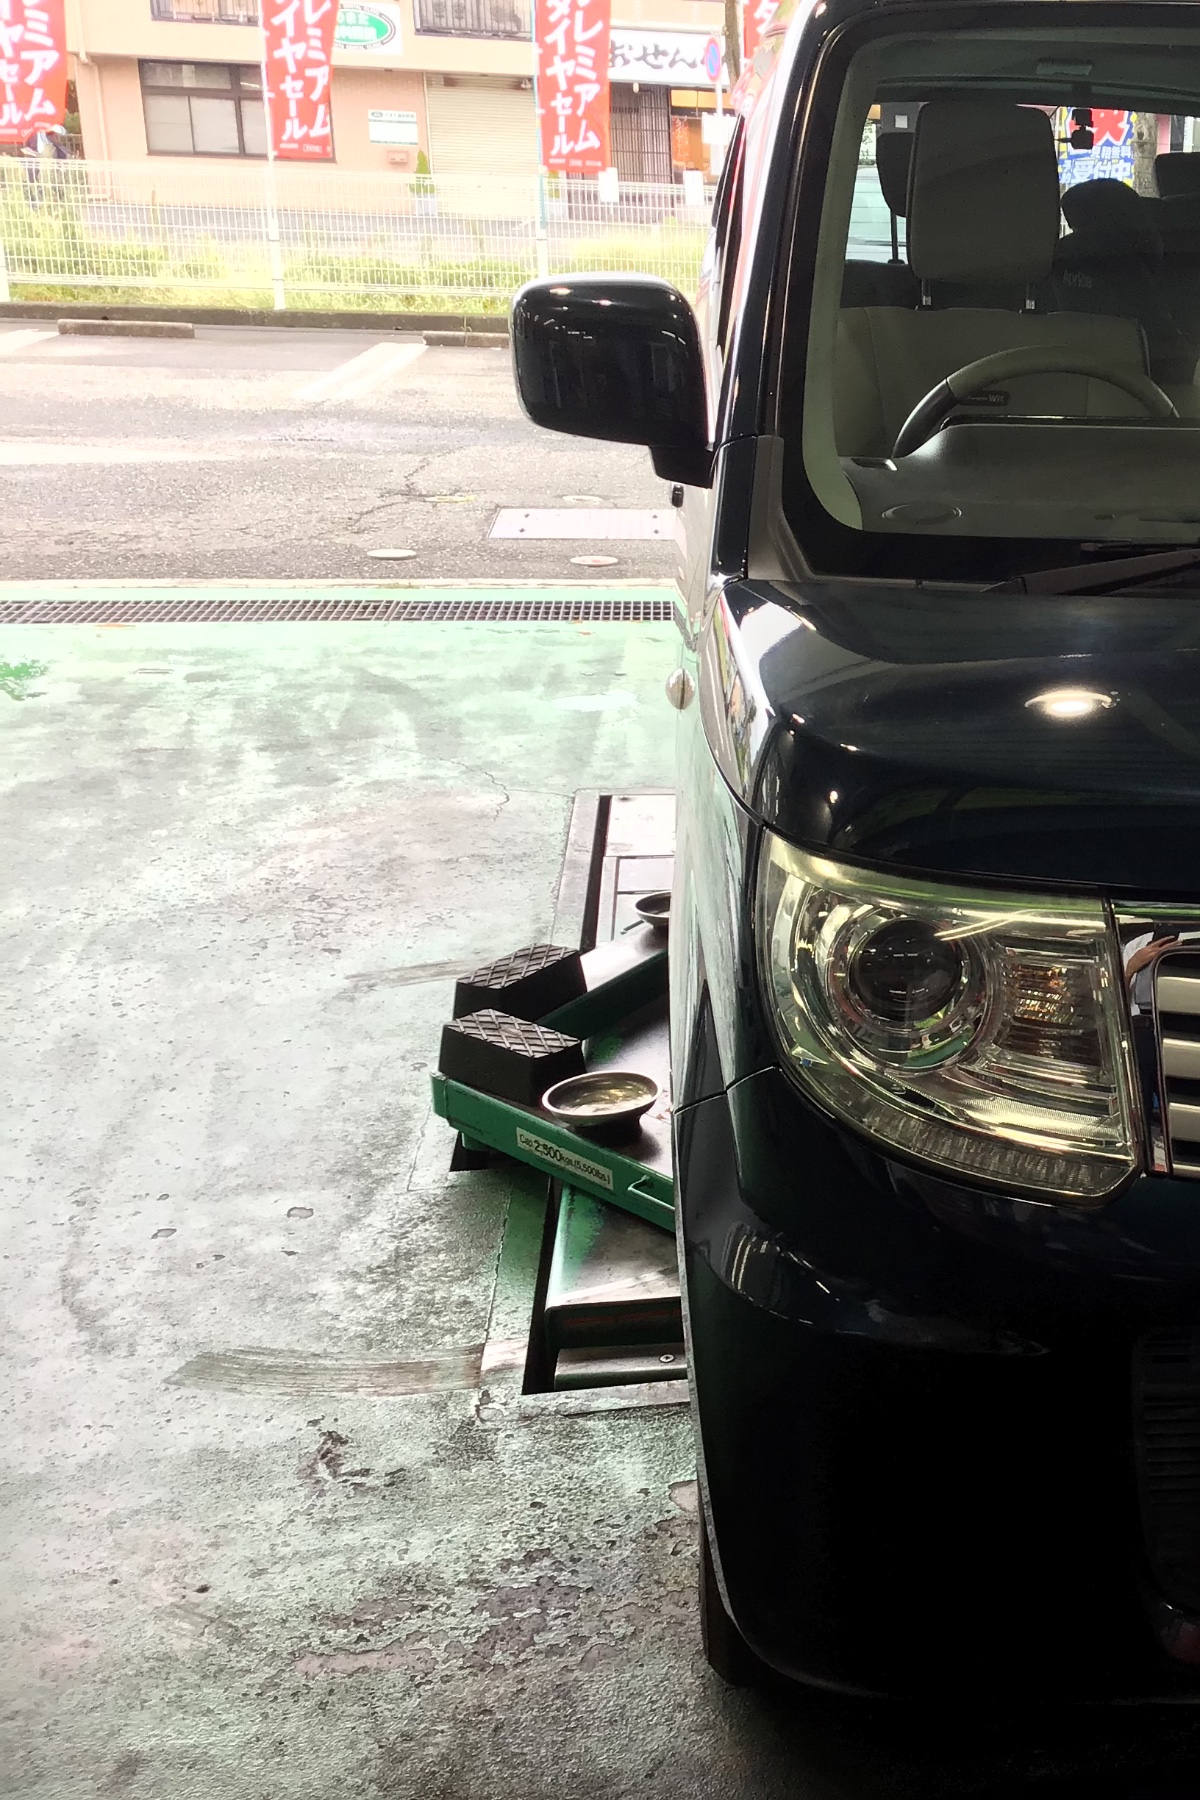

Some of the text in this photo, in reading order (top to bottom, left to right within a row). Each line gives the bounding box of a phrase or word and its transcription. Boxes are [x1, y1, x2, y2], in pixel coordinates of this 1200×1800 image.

[20, 0, 60, 122] ミアム
[270, 0, 309, 142] イヤセール
[574, 0, 604, 153] レミアム
